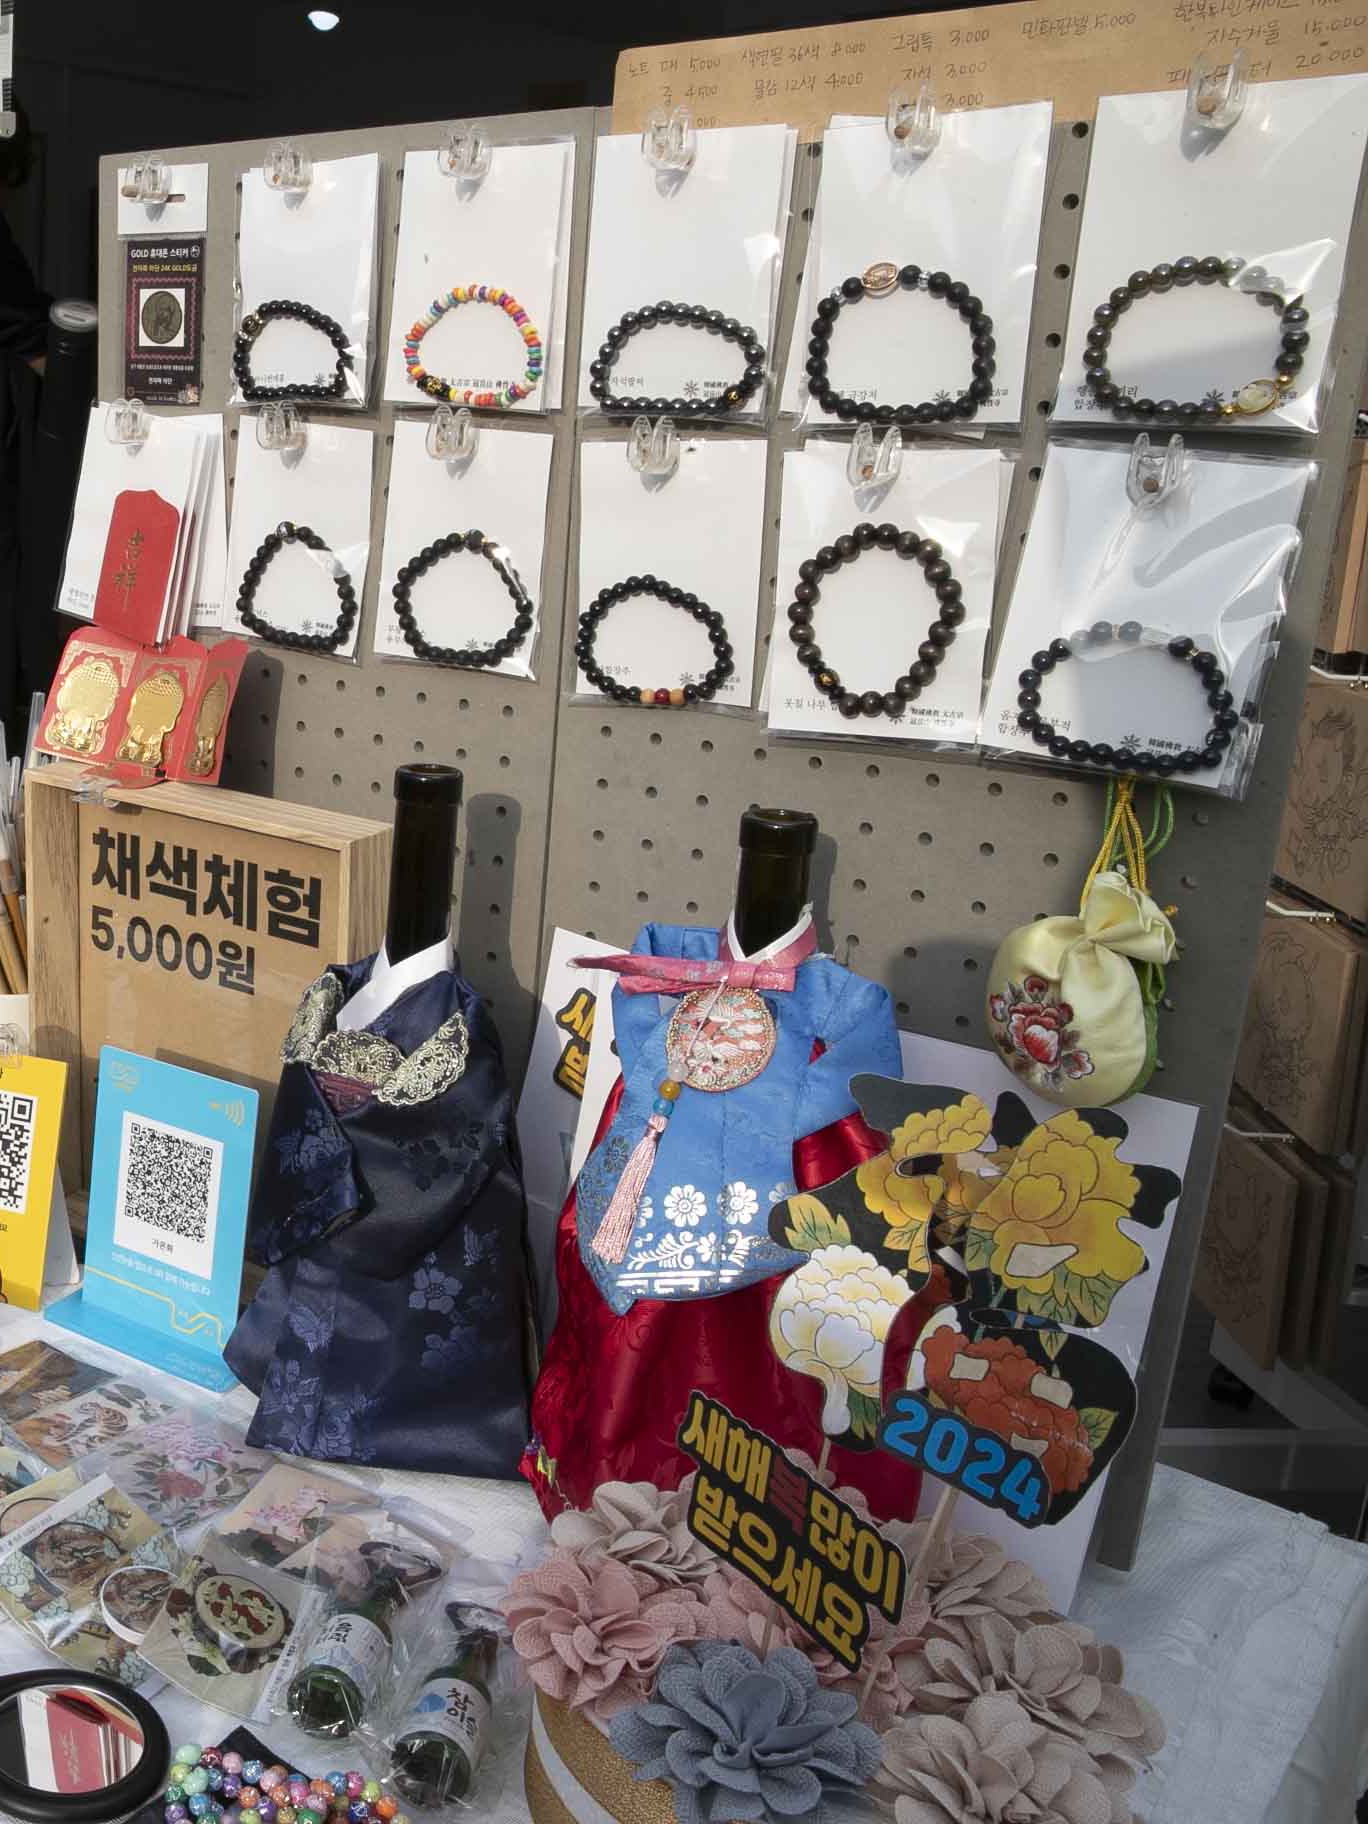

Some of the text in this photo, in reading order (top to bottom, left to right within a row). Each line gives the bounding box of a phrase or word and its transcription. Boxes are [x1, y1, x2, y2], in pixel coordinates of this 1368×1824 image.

[91, 827, 322, 949] 채색체험
[91, 905, 256, 995] 5,000원
[683, 1399, 772, 1502] 새해
[809, 1488, 902, 1615] 많이
[882, 1397, 1042, 1521] 2024
[693, 1475, 866, 1665] 받으세요
